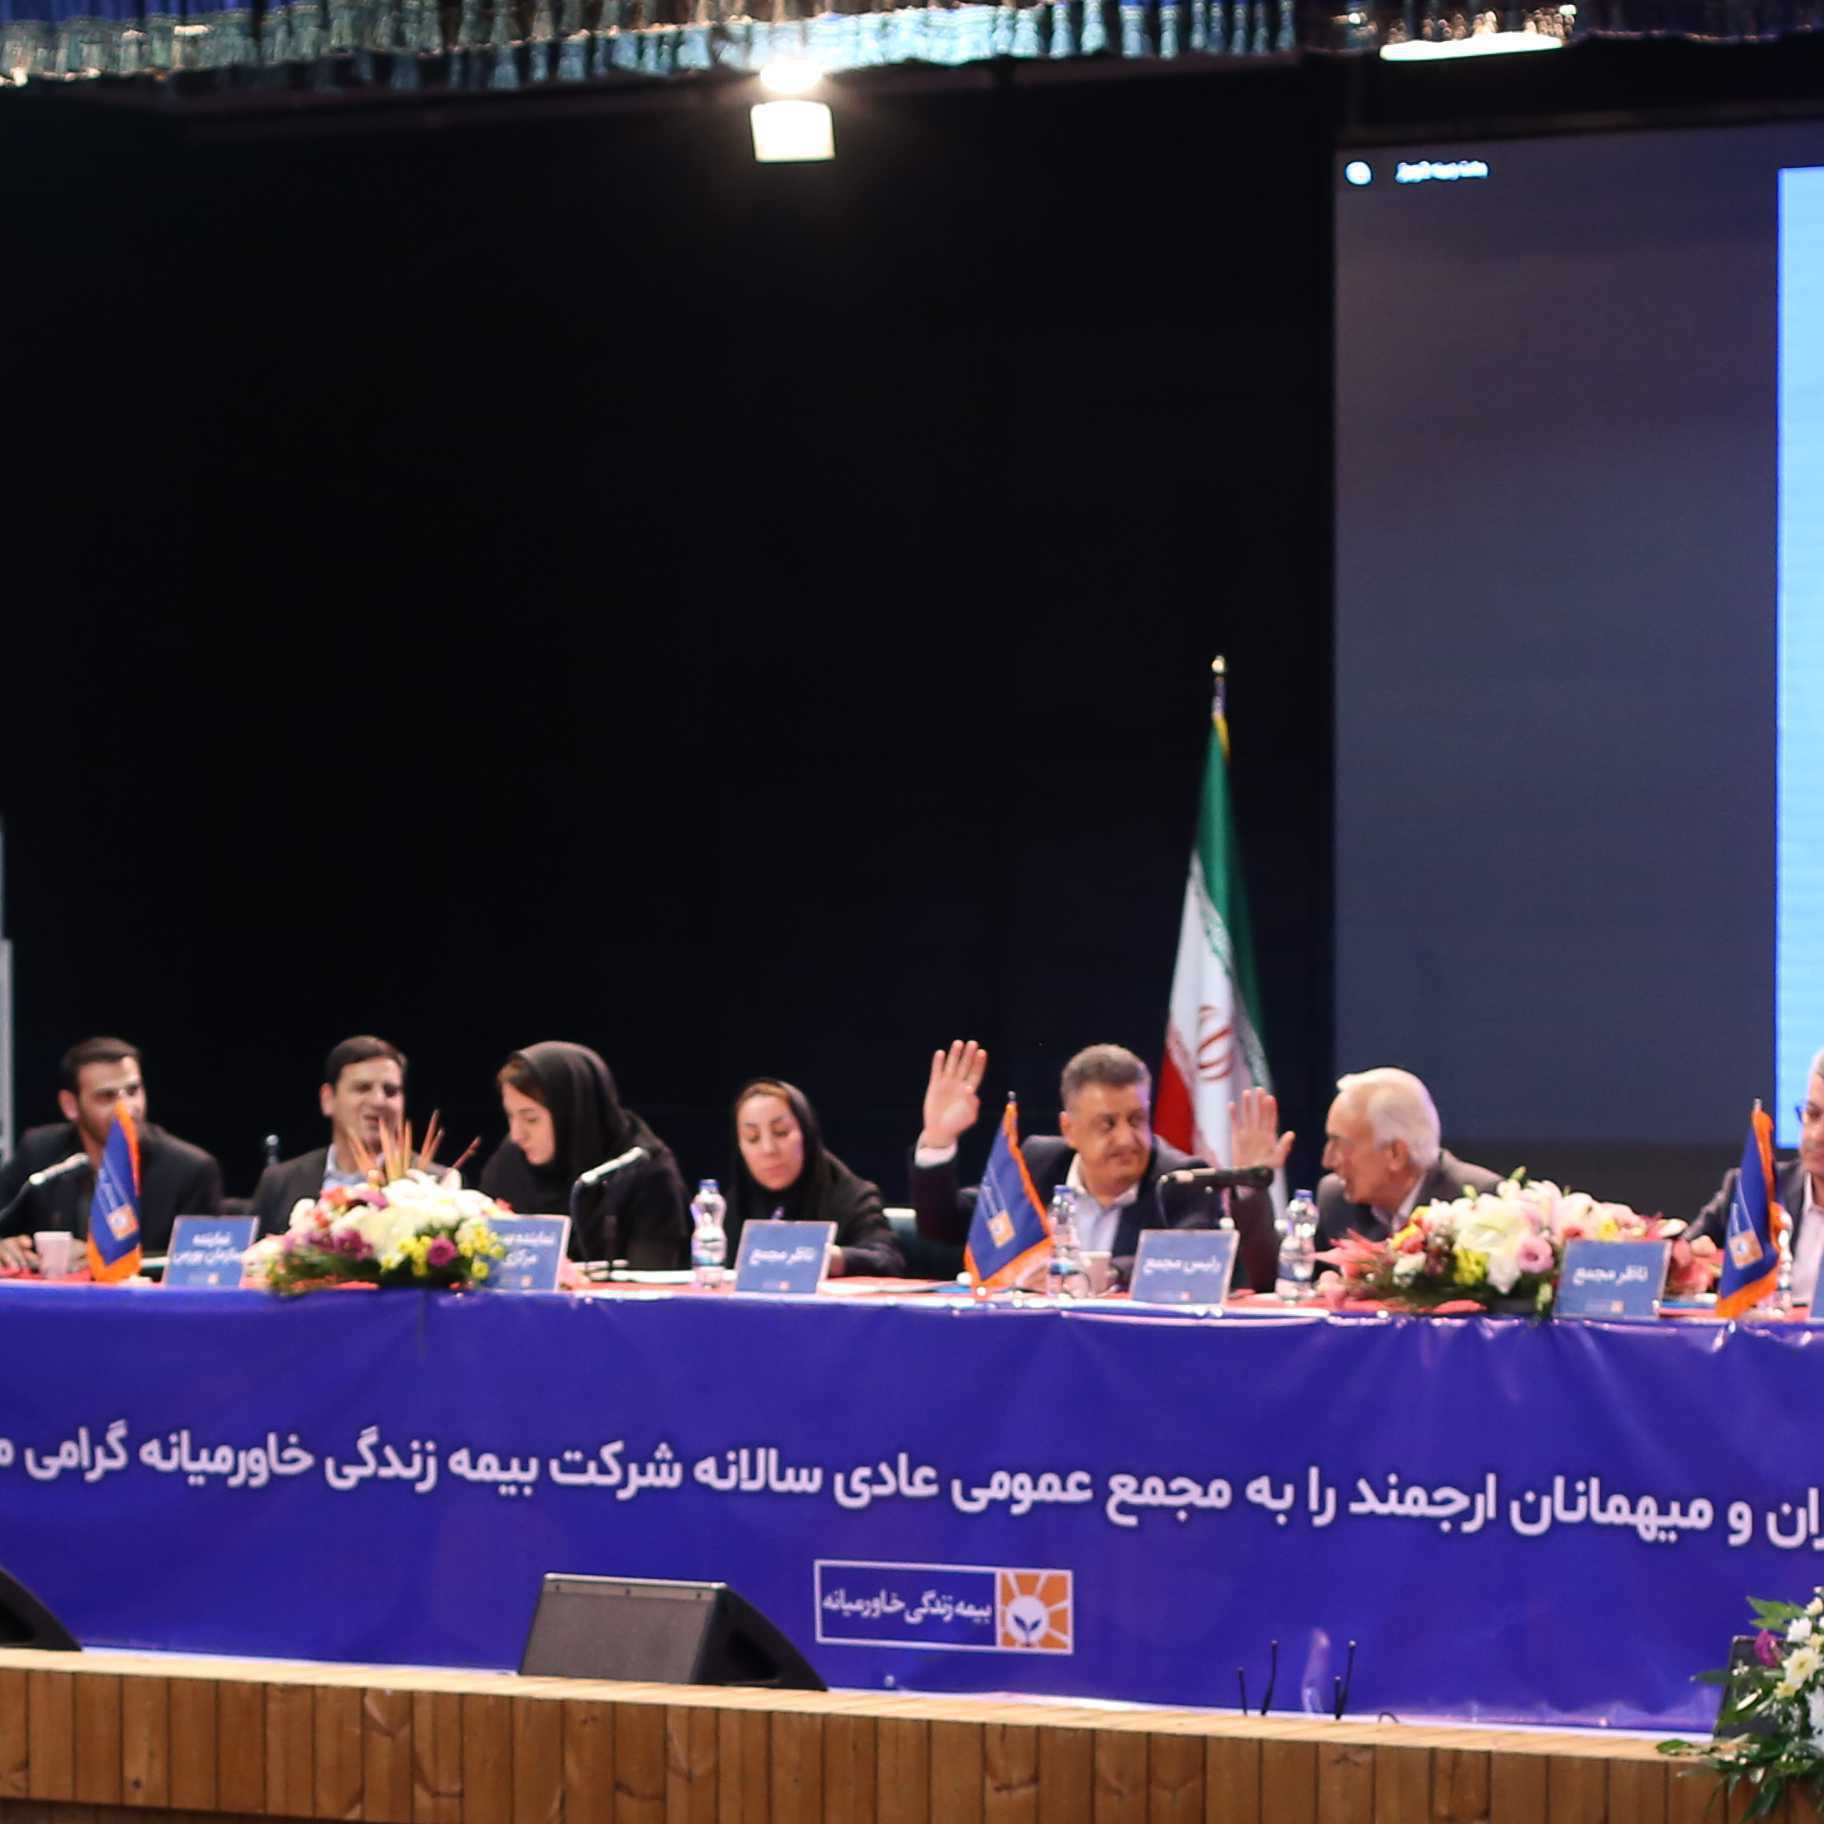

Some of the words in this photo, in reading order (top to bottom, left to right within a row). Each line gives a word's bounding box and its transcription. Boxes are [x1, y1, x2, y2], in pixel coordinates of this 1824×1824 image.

[1572, 1266, 1616, 1287] مجمع
[24, 1418, 128, 1482] گرامی
[138, 1429, 315, 1488] خاورمیانه
[324, 1424, 438, 1494] زندگی
[447, 1446, 539, 1497] بیمه
[548, 1440, 683, 1501] شرکت
[693, 1447, 822, 1493] سالانه
[833, 1451, 940, 1509] عادی
[950, 1469, 1094, 1515] عمومی
[1105, 1472, 1233, 1527] مجمع
[1245, 1474, 1295, 1526] به
[1307, 1465, 1337, 1528] را
[1348, 1472, 1497, 1534] ارجمند
[1509, 1474, 1714, 1543] میهمانان
[1727, 1500, 1754, 1547] و
[822, 1588, 906, 1618] خاورمیانه
[904, 1589, 954, 1625] زندگی
[955, 1600, 993, 1625] بیمه
